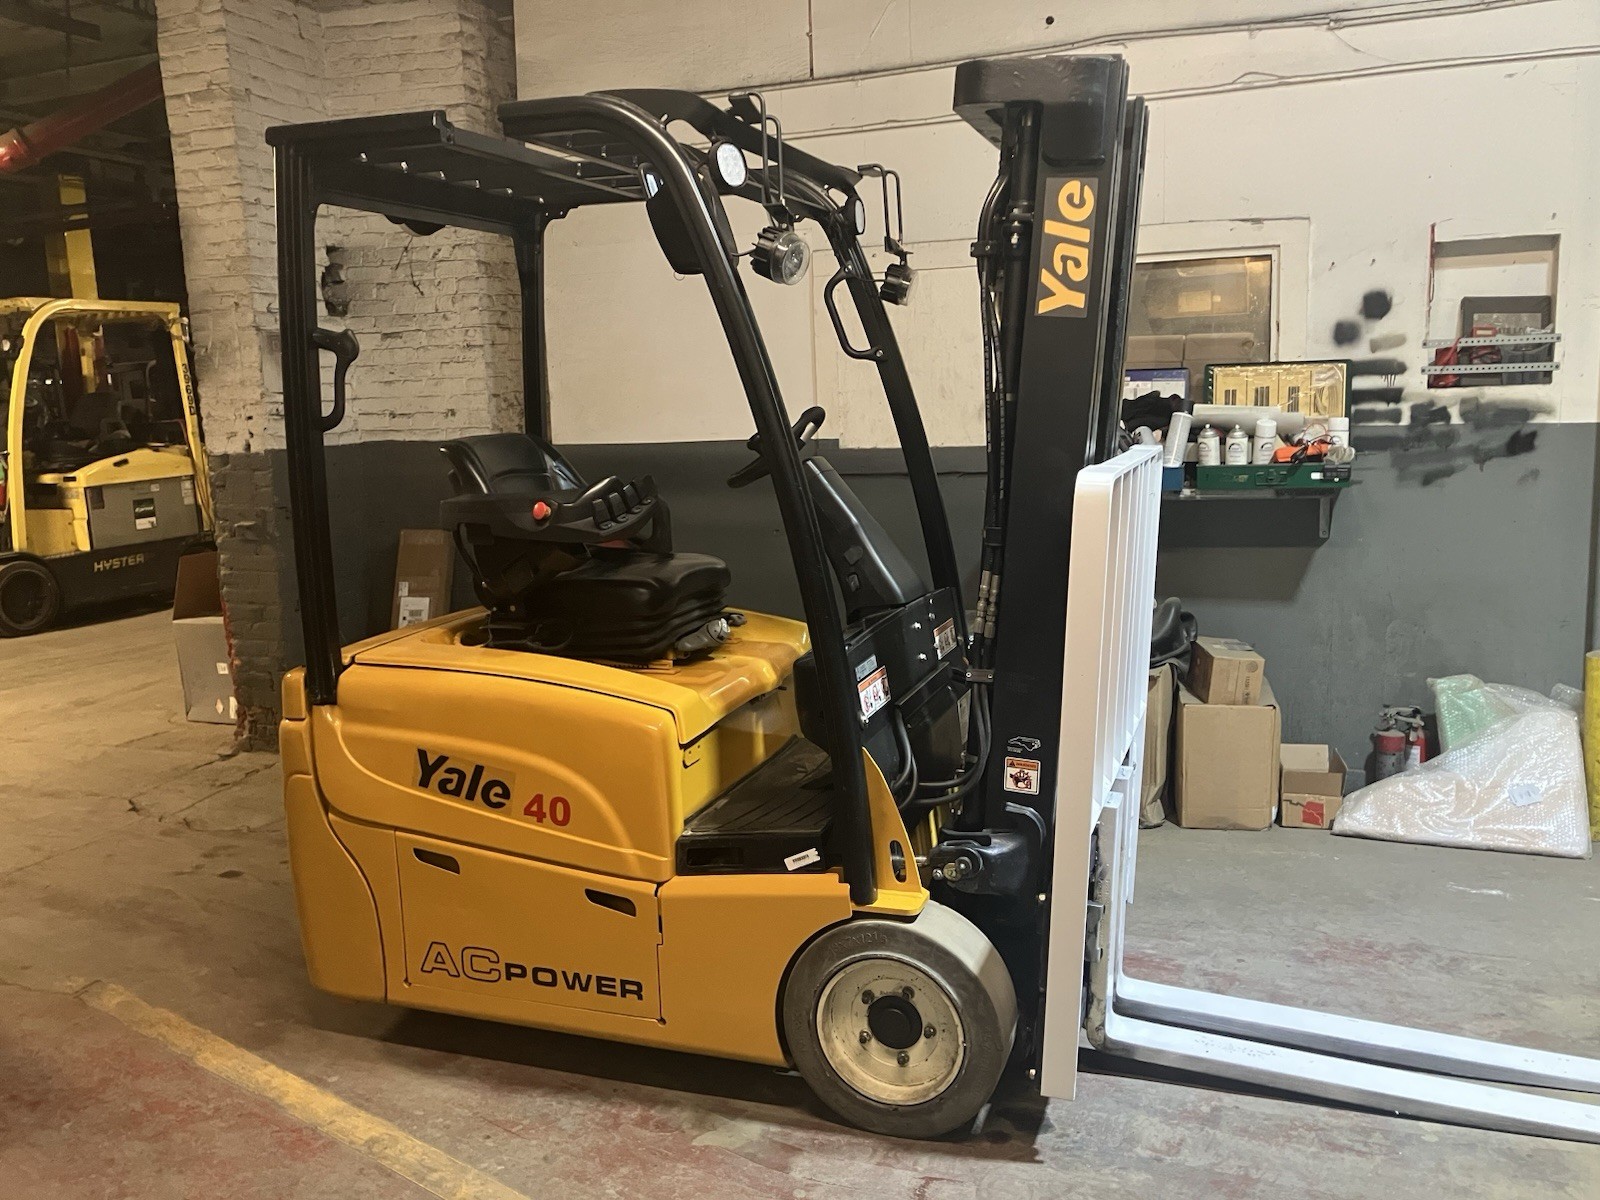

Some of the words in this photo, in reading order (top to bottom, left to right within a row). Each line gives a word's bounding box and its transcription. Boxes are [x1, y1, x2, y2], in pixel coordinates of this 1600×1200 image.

[1037, 179, 1095, 315] Yale
[93, 553, 145, 573] HYSTER
[416, 748, 512, 809] Yale
[523, 793, 571, 827] 40
